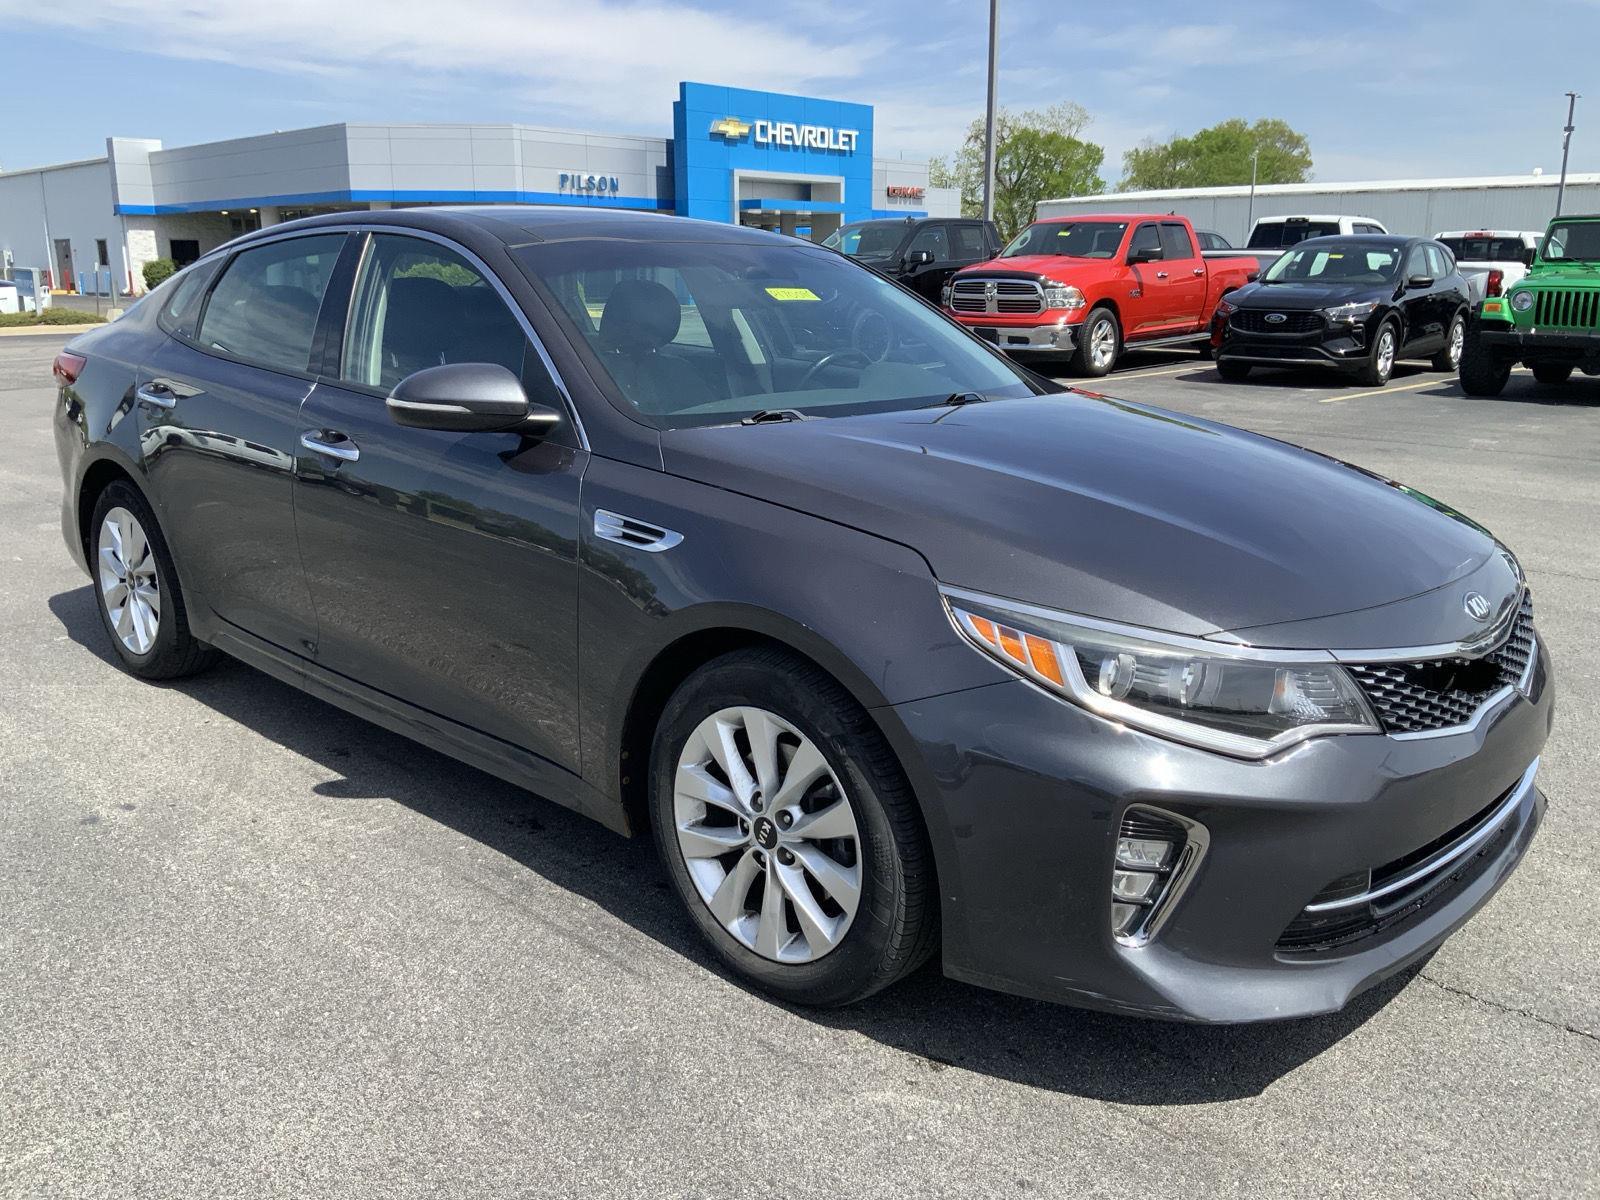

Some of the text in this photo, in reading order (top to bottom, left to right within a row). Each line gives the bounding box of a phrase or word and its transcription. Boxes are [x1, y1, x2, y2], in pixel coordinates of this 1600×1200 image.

[754, 120, 859, 150] CHEVROLET
[560, 173, 619, 192] PILSON
[758, 821, 771, 844] KIA
